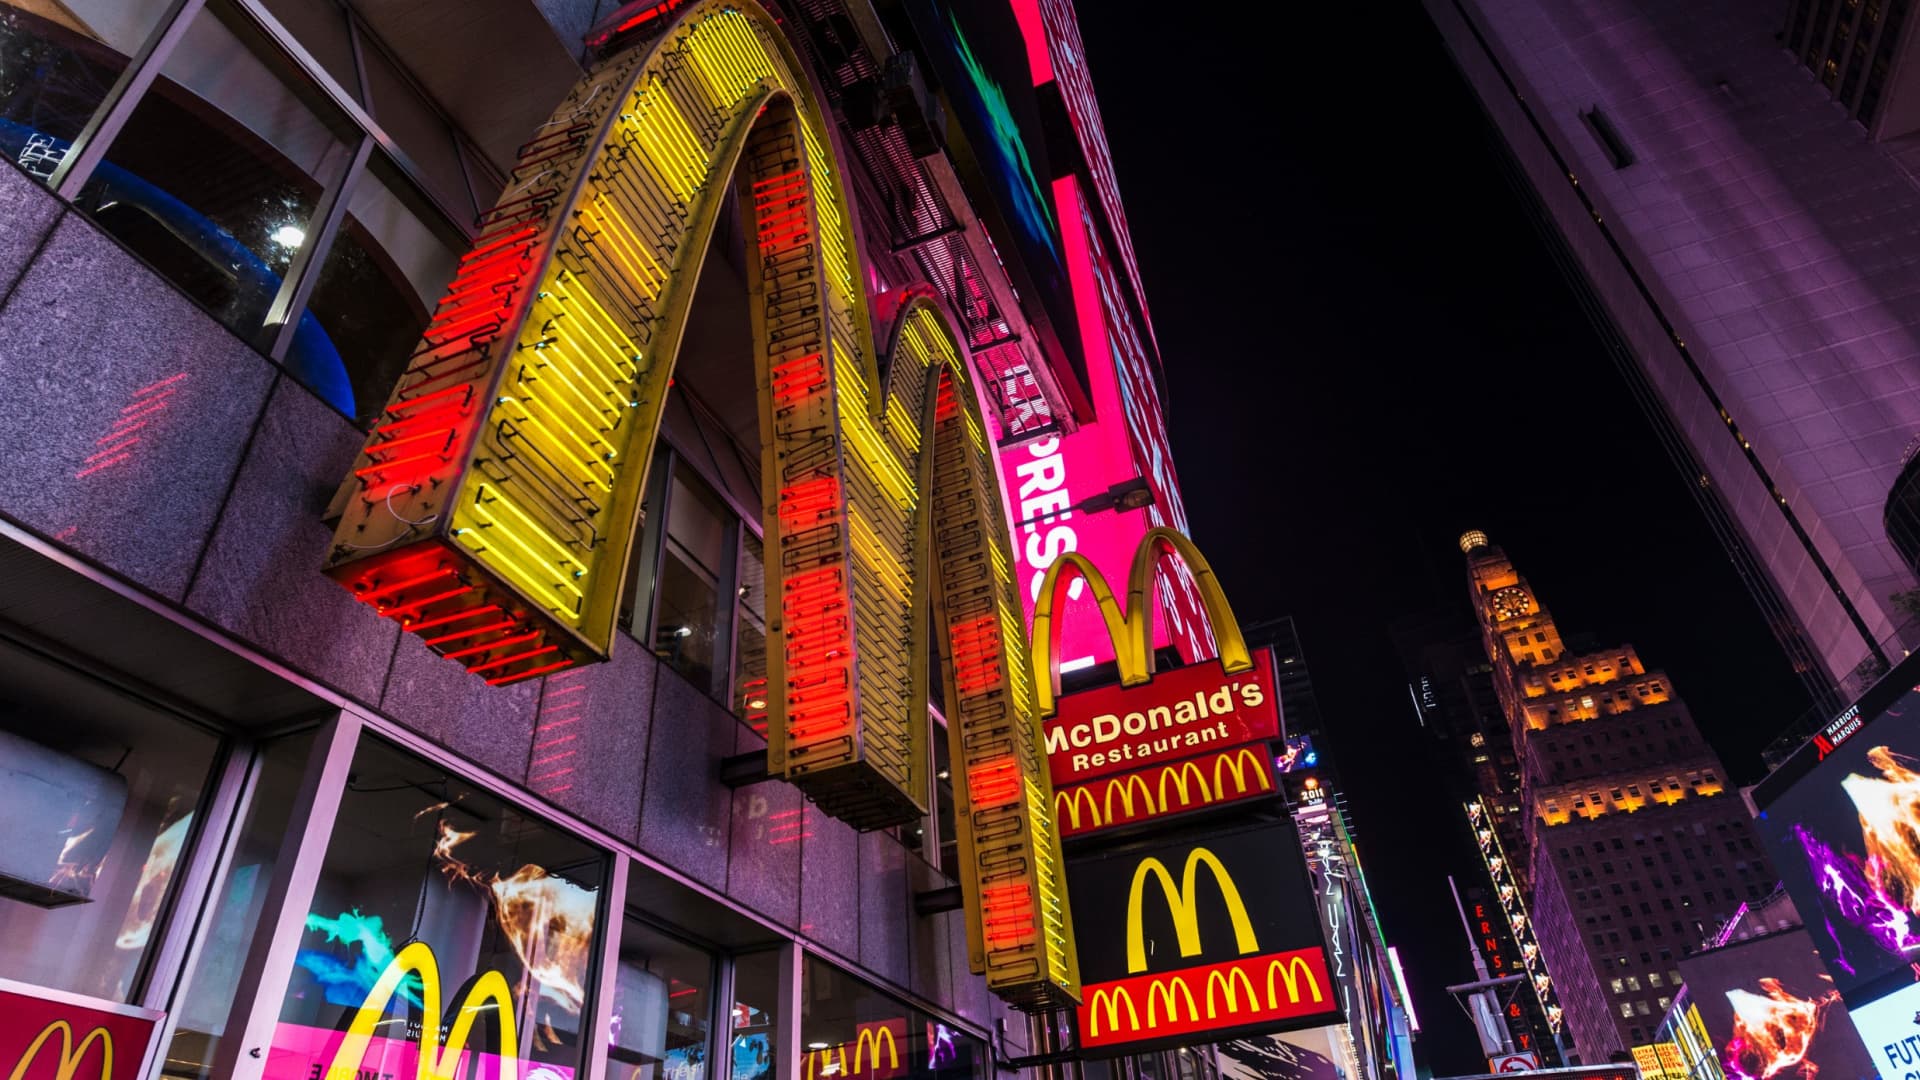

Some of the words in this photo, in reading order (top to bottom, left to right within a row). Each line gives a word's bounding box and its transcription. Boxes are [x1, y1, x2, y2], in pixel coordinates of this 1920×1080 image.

[1043, 682, 1264, 755] McDonald's
[1826, 704, 1860, 736] MARRIOTT
[1831, 717, 1862, 745] MARQUIS
[1073, 721, 1229, 772] Restaurant
[1884, 1034, 1920, 1070] FUT
